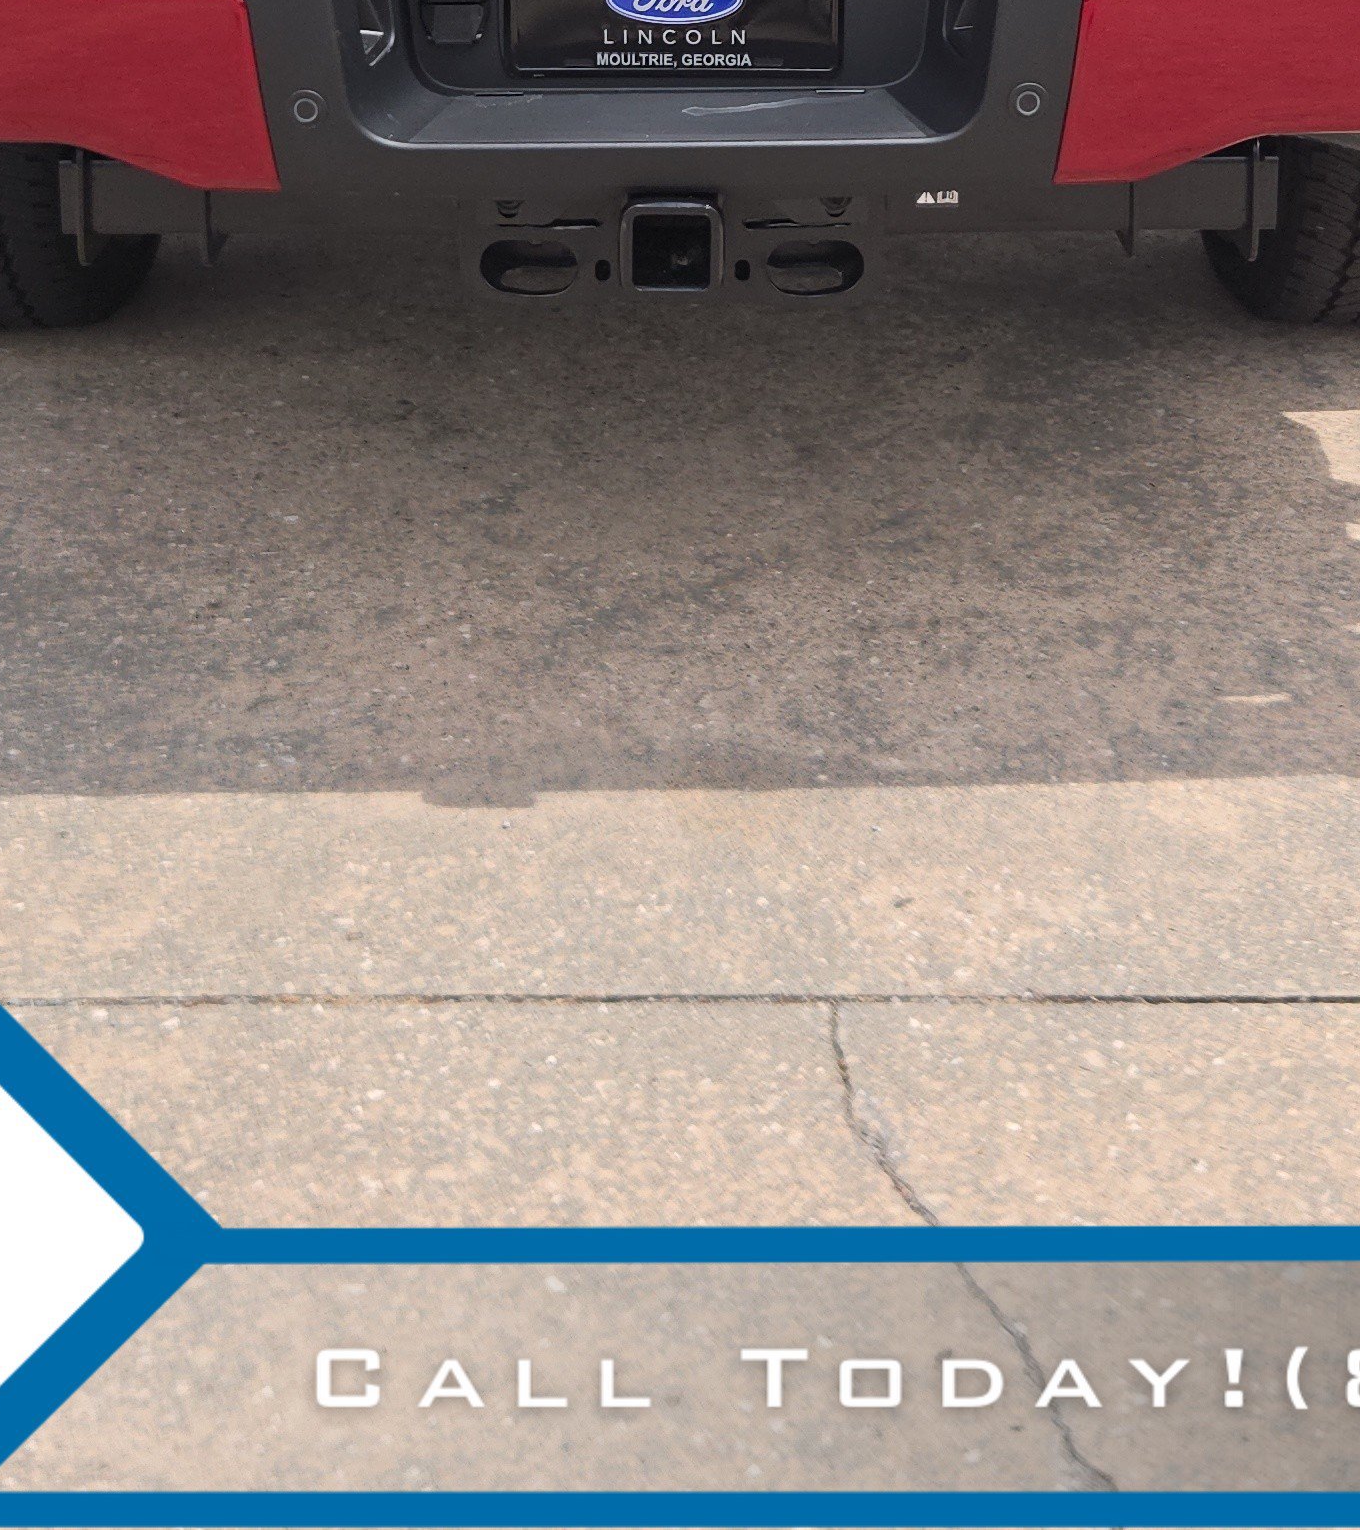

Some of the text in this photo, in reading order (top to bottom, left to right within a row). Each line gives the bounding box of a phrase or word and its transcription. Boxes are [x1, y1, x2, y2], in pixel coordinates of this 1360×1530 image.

[603, 29, 748, 45] LINCOLN
[596, 52, 752, 68] MOULTRIE, GEORGIA
